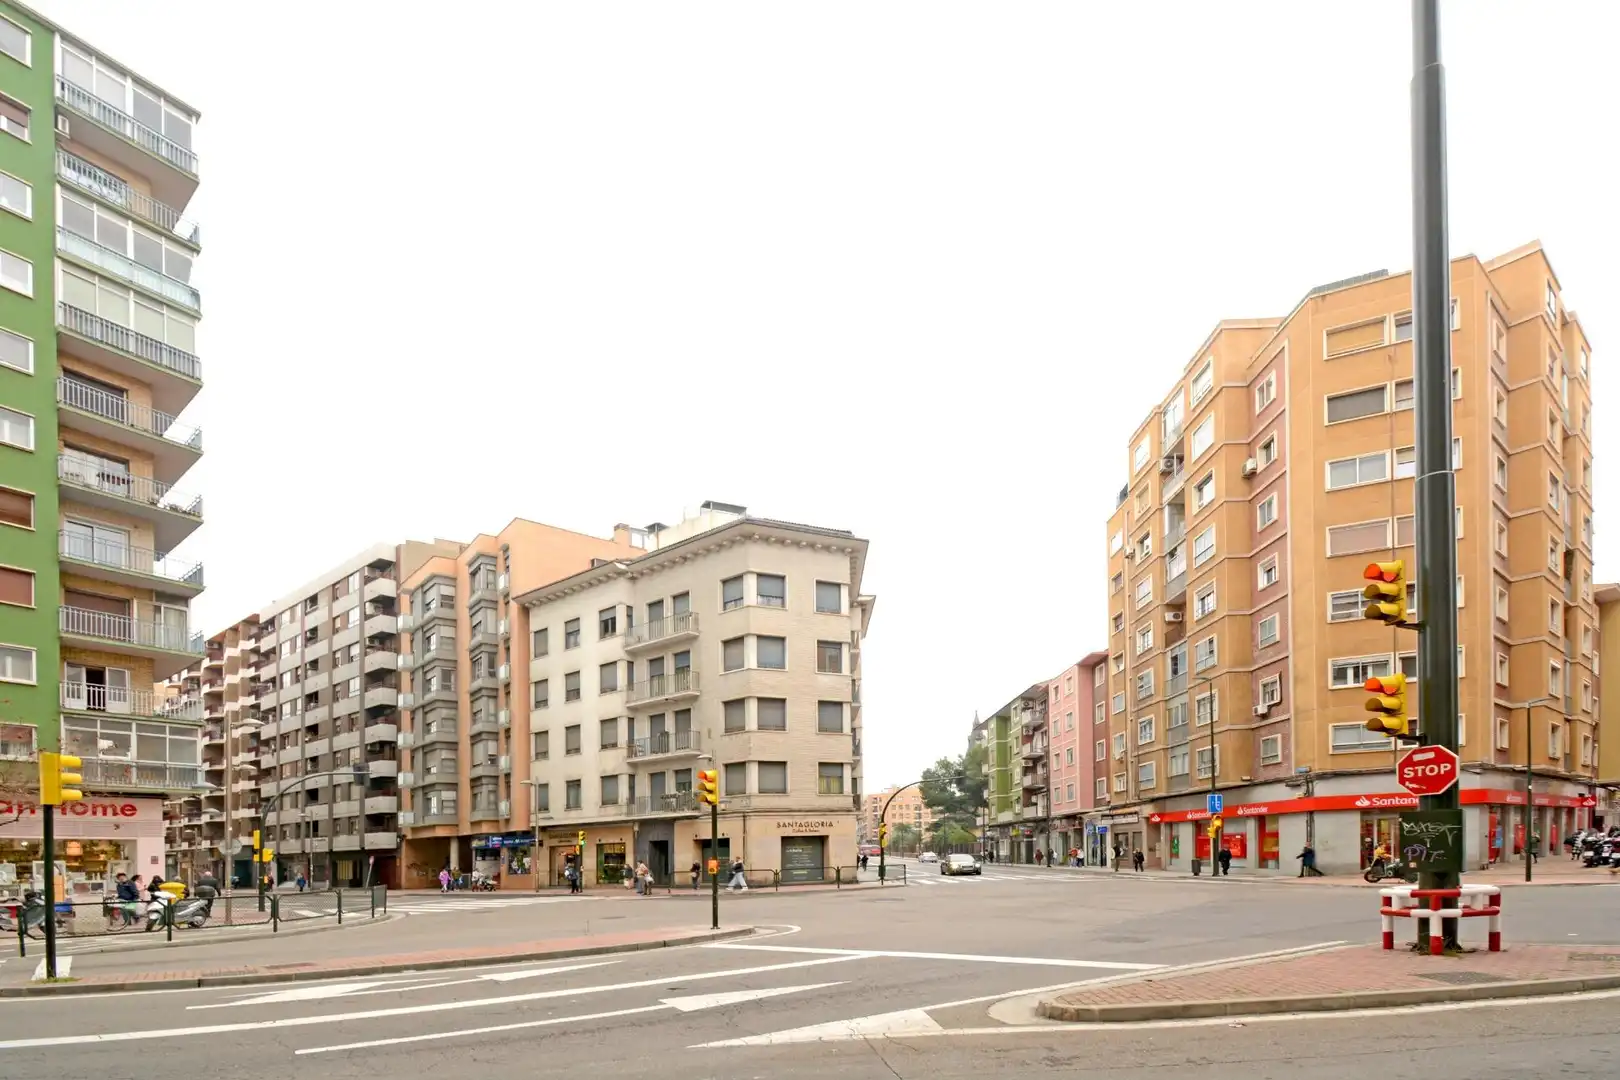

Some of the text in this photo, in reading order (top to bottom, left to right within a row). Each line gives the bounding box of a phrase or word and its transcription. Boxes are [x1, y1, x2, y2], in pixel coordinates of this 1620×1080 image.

[1403, 763, 1452, 778] STOP
[1372, 797, 1419, 806] Santan
[1243, 806, 1268, 815] Santander
